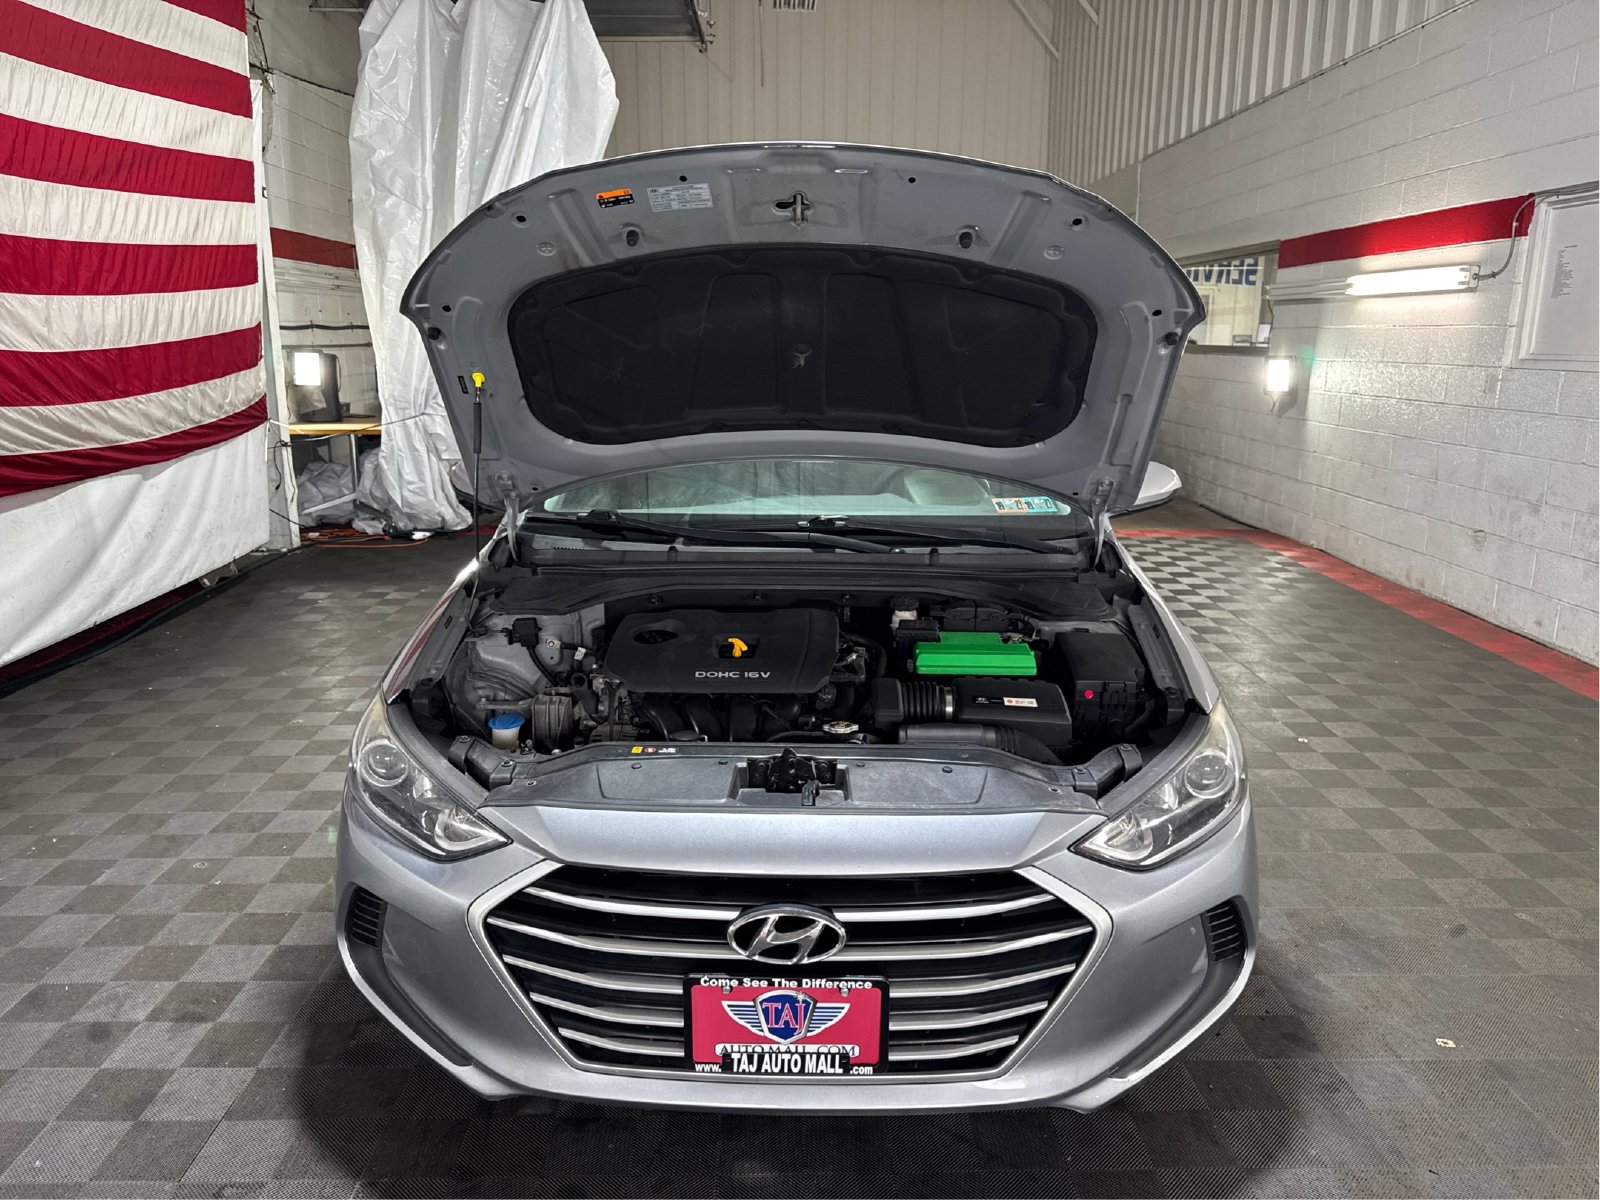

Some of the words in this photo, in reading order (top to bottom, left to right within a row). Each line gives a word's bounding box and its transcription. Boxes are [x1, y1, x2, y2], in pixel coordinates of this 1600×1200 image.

[700, 976, 739, 987] Come
[743, 977, 768, 988] See
[772, 978, 798, 988] The
[802, 979, 873, 989] Difference
[762, 1002, 805, 1035] TAJ
[695, 1063, 722, 1073] www.
[731, 1053, 758, 1073] TAJ
[761, 1053, 802, 1074] AUTO
[804, 1054, 844, 1074] MALL
[849, 1065, 874, 1075] .com
